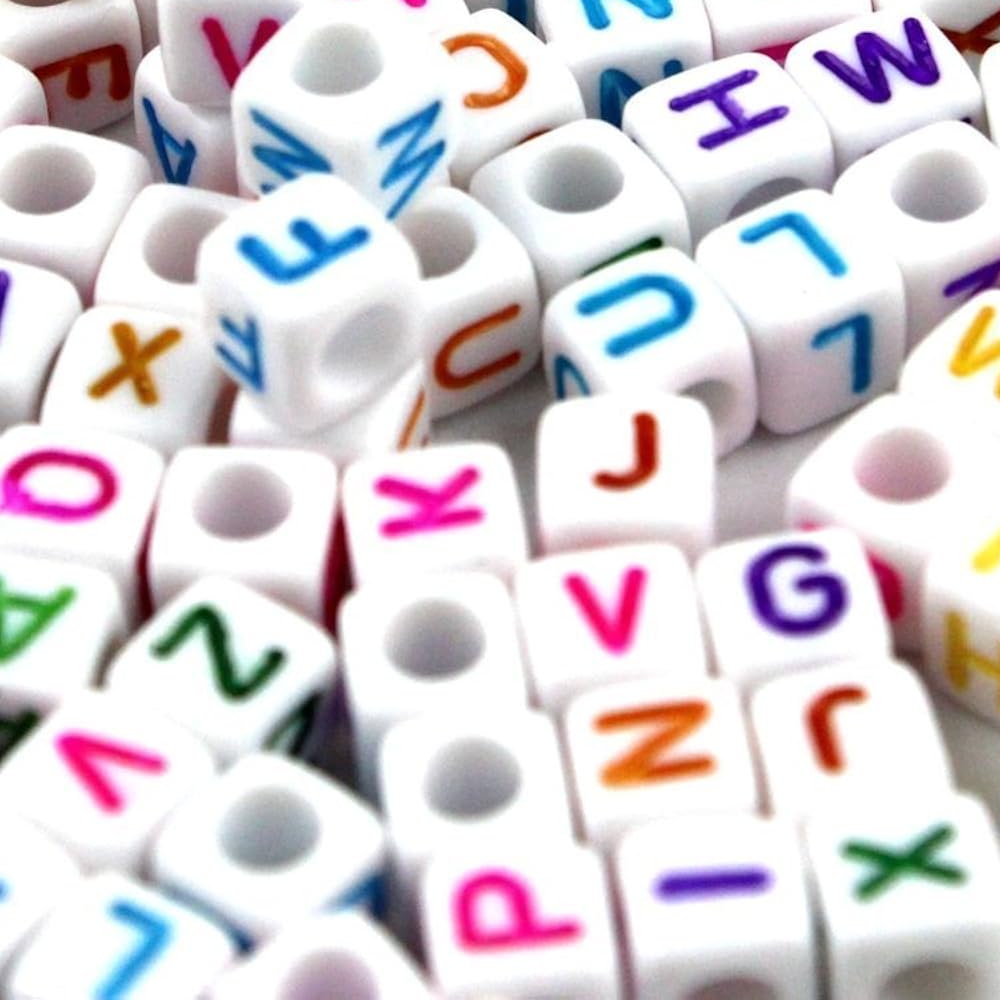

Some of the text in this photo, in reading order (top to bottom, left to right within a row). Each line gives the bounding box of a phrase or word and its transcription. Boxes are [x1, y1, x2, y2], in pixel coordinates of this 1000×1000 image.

[813, 17, 941, 104] W
[669, 67, 790, 151] H
[234, 216, 373, 287] F
[574, 271, 699, 360] U
[87, 322, 184, 405] X
[590, 411, 660, 491] J
[371, 463, 487, 541] K
[561, 564, 650, 657] V
[744, 544, 848, 636] G
[840, 820, 970, 904] X
[449, 866, 584, 955] P
